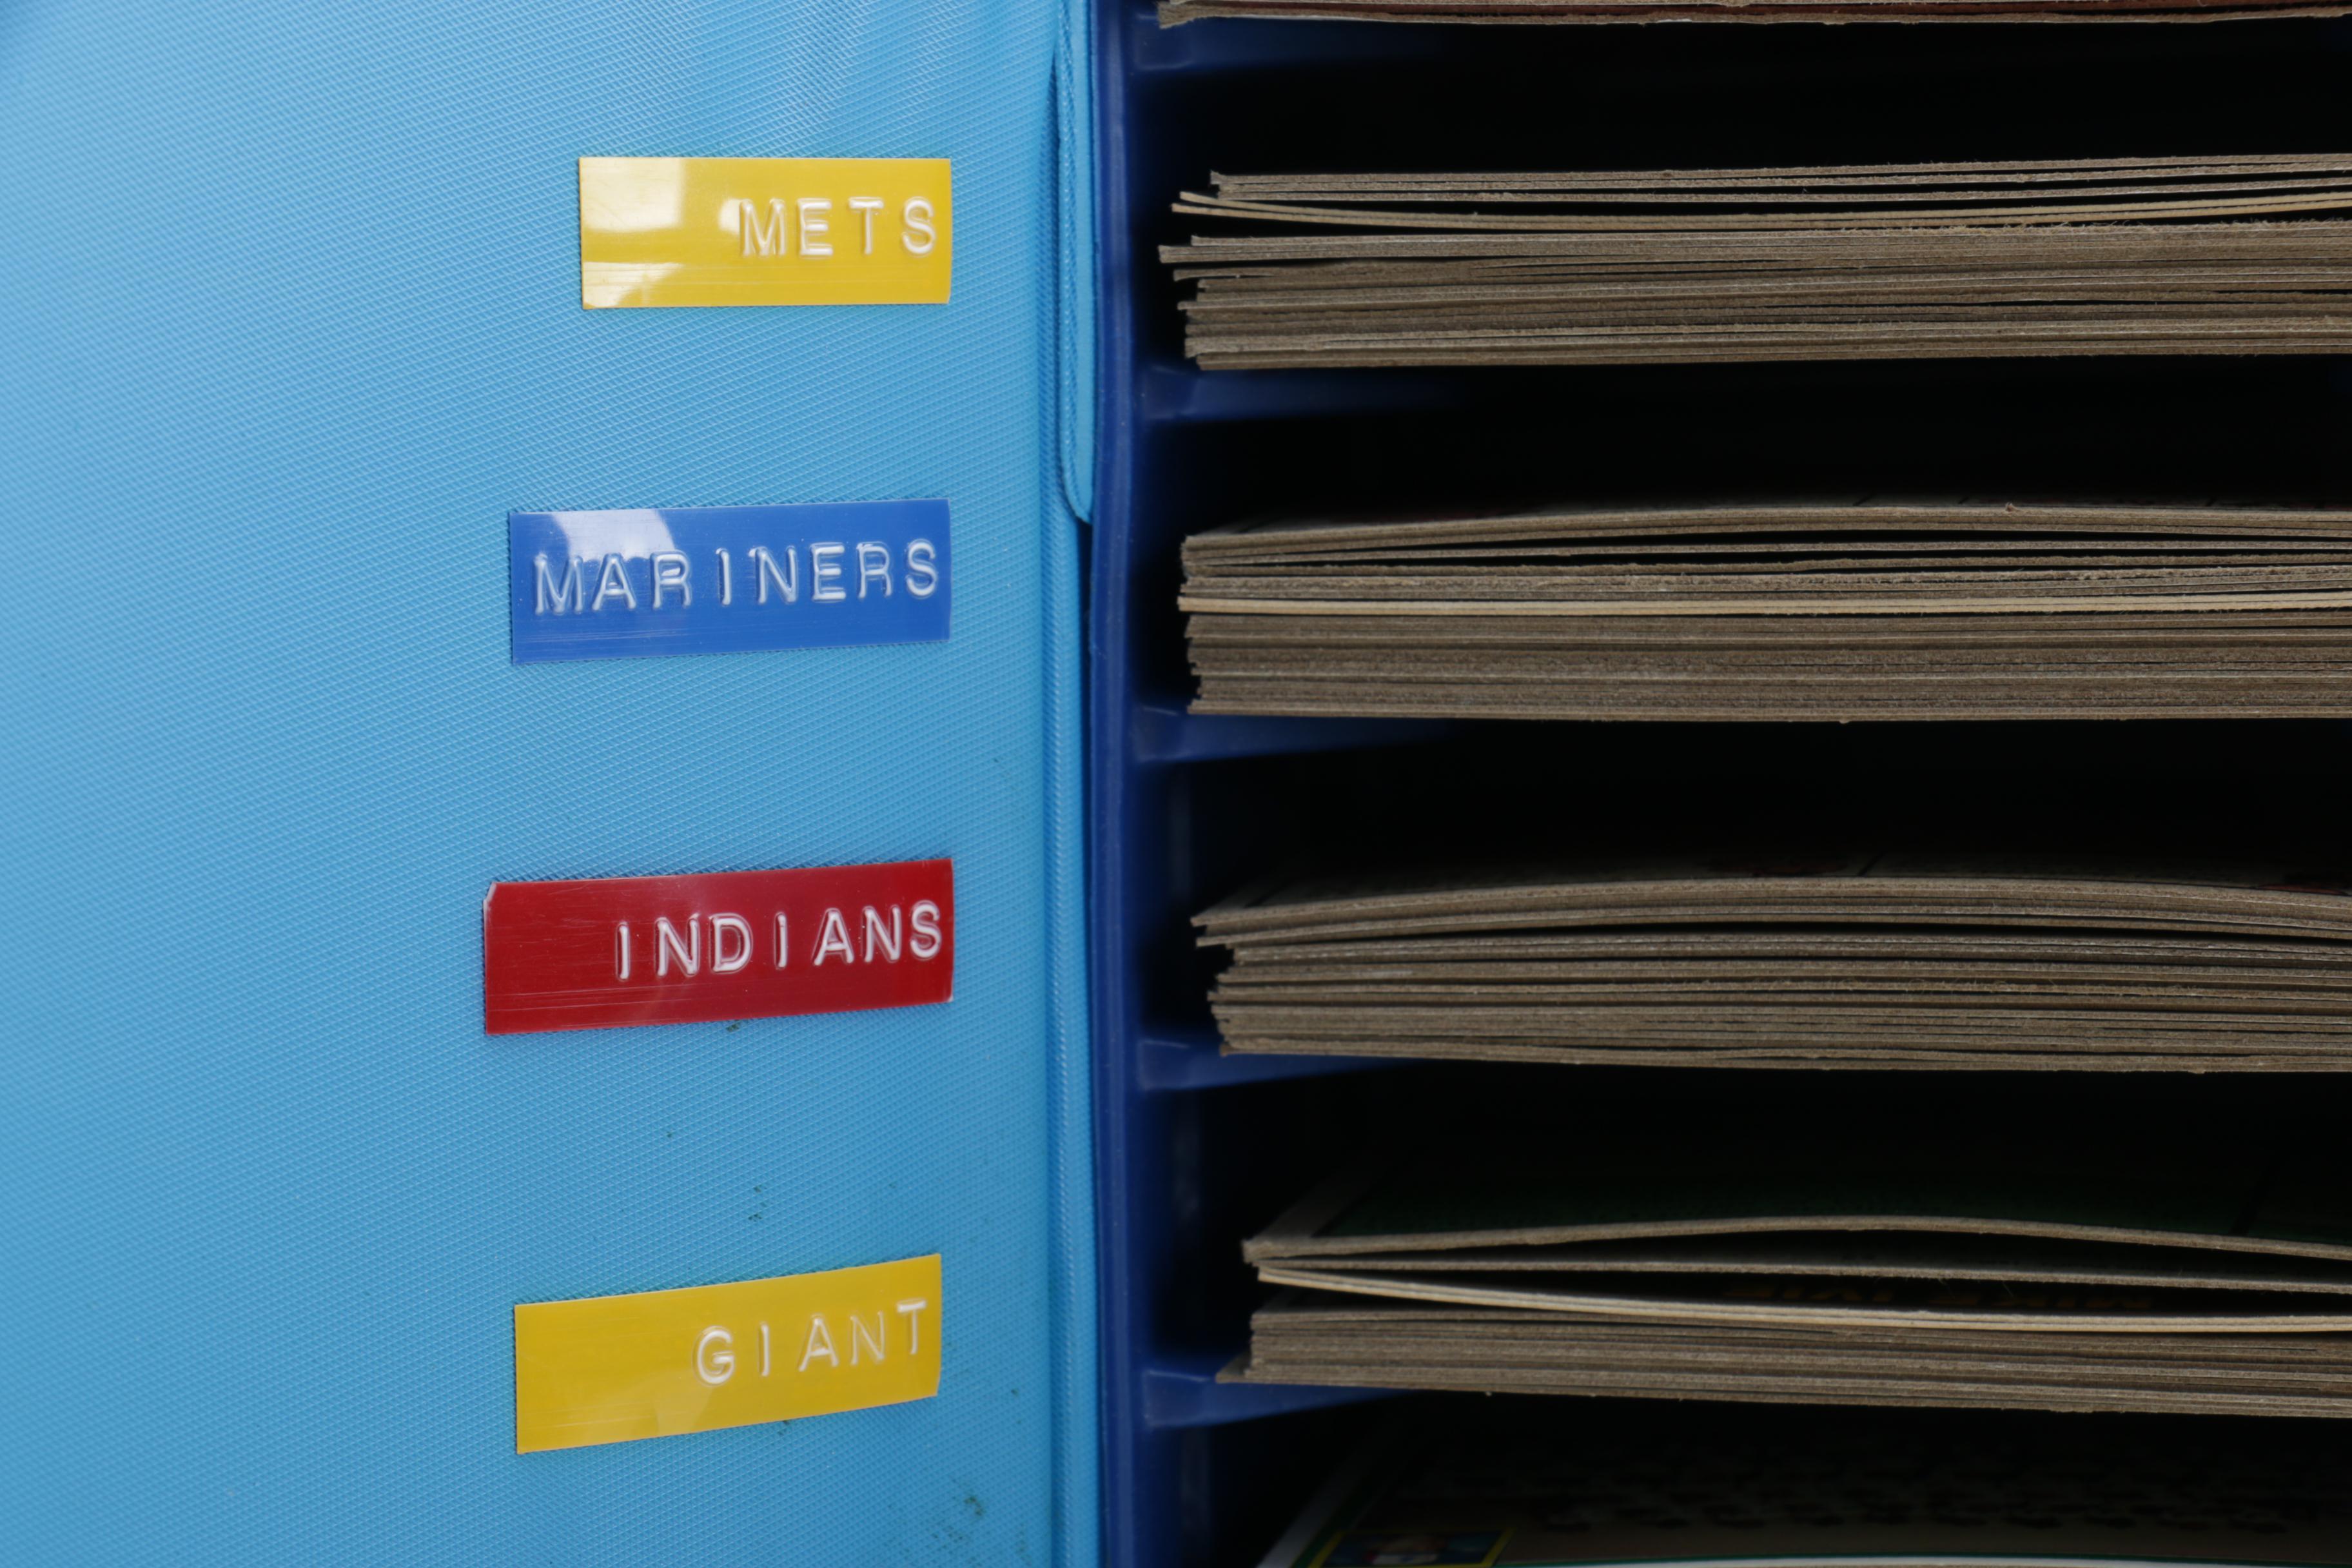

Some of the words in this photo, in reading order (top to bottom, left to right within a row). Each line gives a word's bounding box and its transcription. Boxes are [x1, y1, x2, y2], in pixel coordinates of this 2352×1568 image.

[739, 196, 936, 257] METS
[533, 538, 939, 614] MARINERS
[616, 901, 943, 980] INDIANS
[694, 1298, 926, 1386] GIANT
